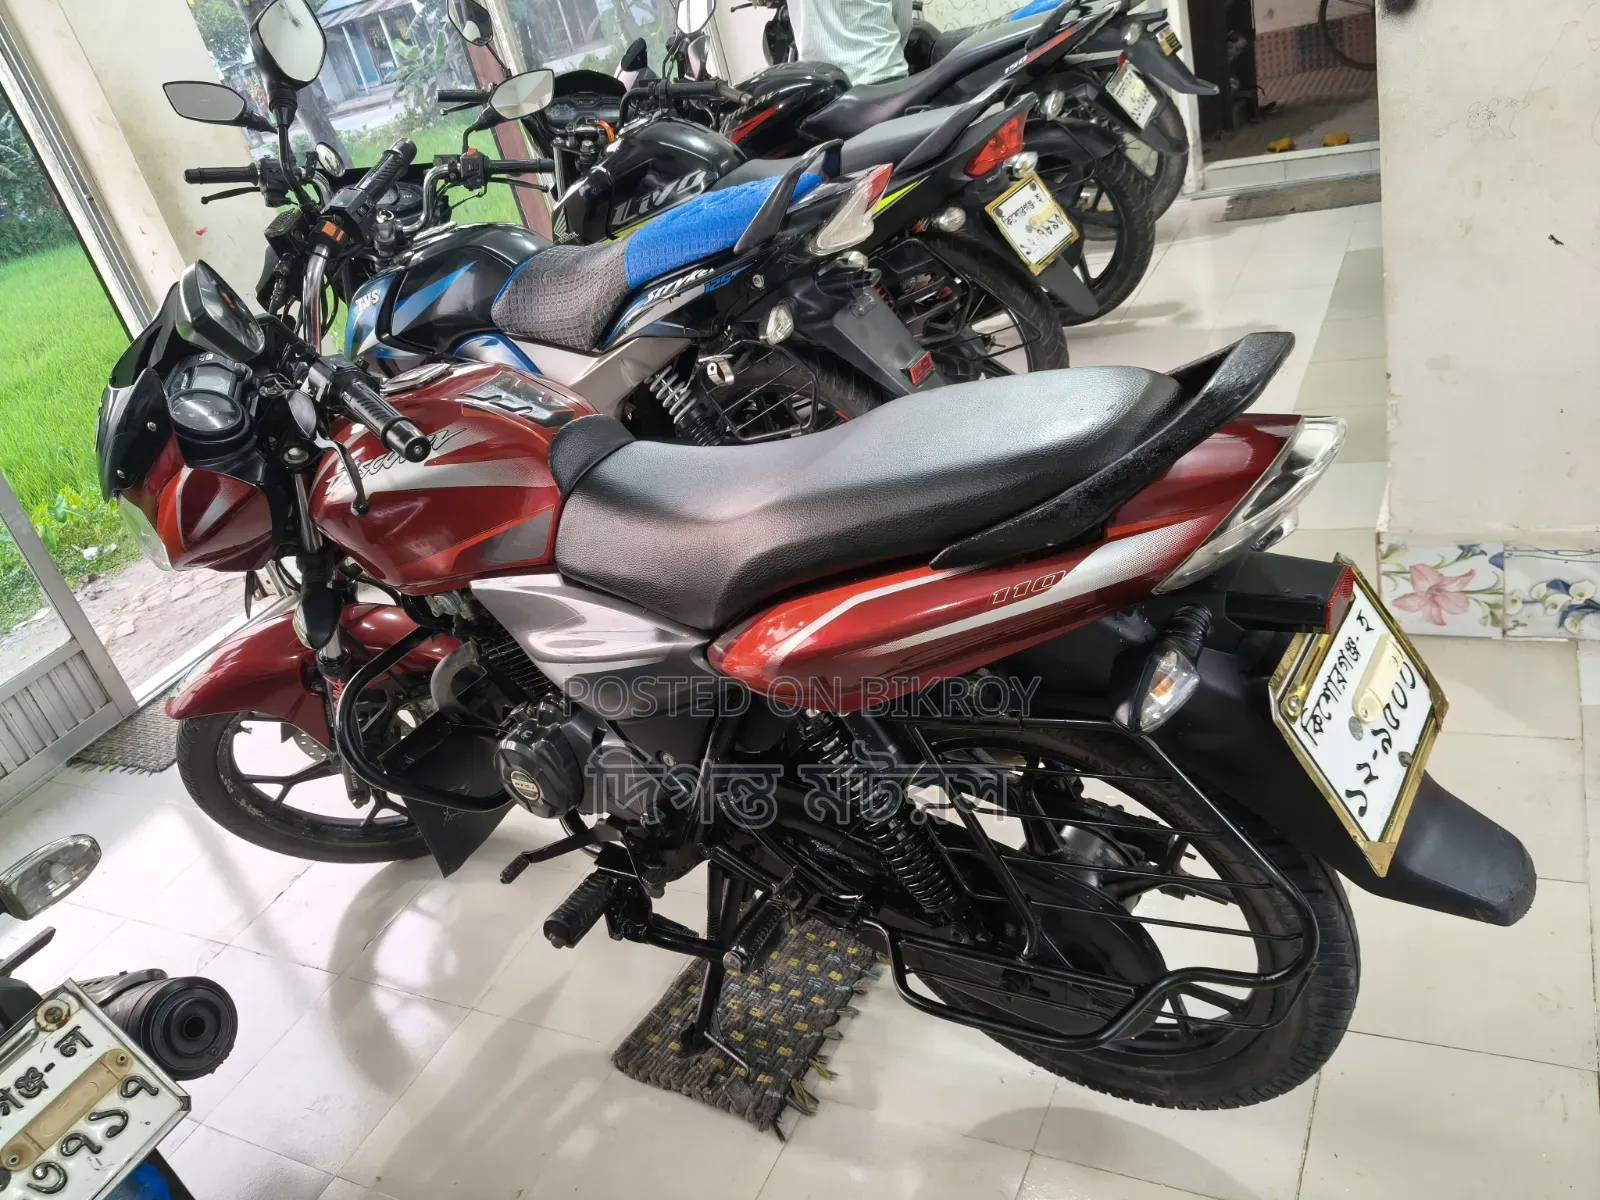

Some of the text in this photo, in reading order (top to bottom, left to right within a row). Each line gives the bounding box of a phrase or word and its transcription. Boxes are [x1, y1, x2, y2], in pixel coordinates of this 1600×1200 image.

[1004, 55, 1028, 74] 150
[703, 271, 733, 295] 125
[354, 288, 381, 312] TVS
[992, 570, 1067, 605] 110
